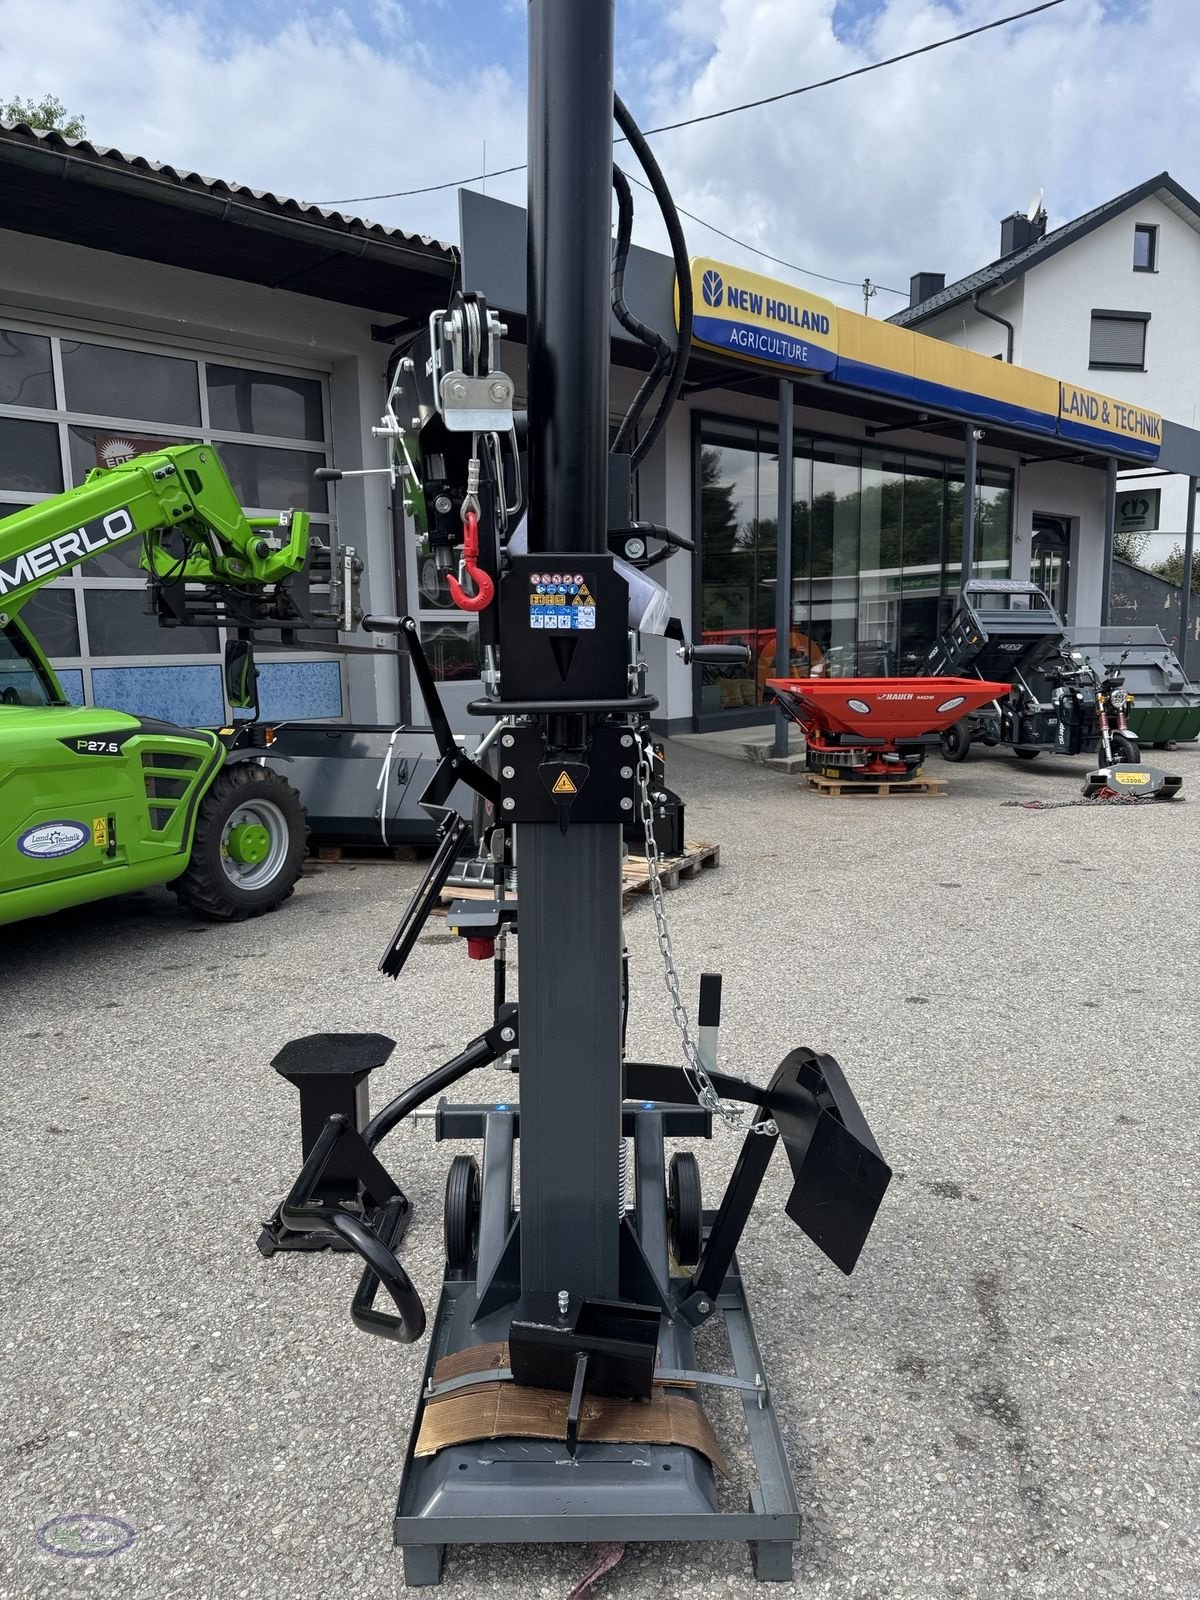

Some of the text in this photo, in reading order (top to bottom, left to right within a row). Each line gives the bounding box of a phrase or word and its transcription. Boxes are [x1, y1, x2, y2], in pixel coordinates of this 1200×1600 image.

[727, 286, 830, 335] NEW HOLLAND
[729, 328, 808, 362] AGRICULTURE
[1062, 387, 1160, 439] LAND & TECHNIK
[0, 509, 133, 594] MERLO
[76, 740, 118, 753] P27.6
[32, 833, 80, 844] Land Technik
